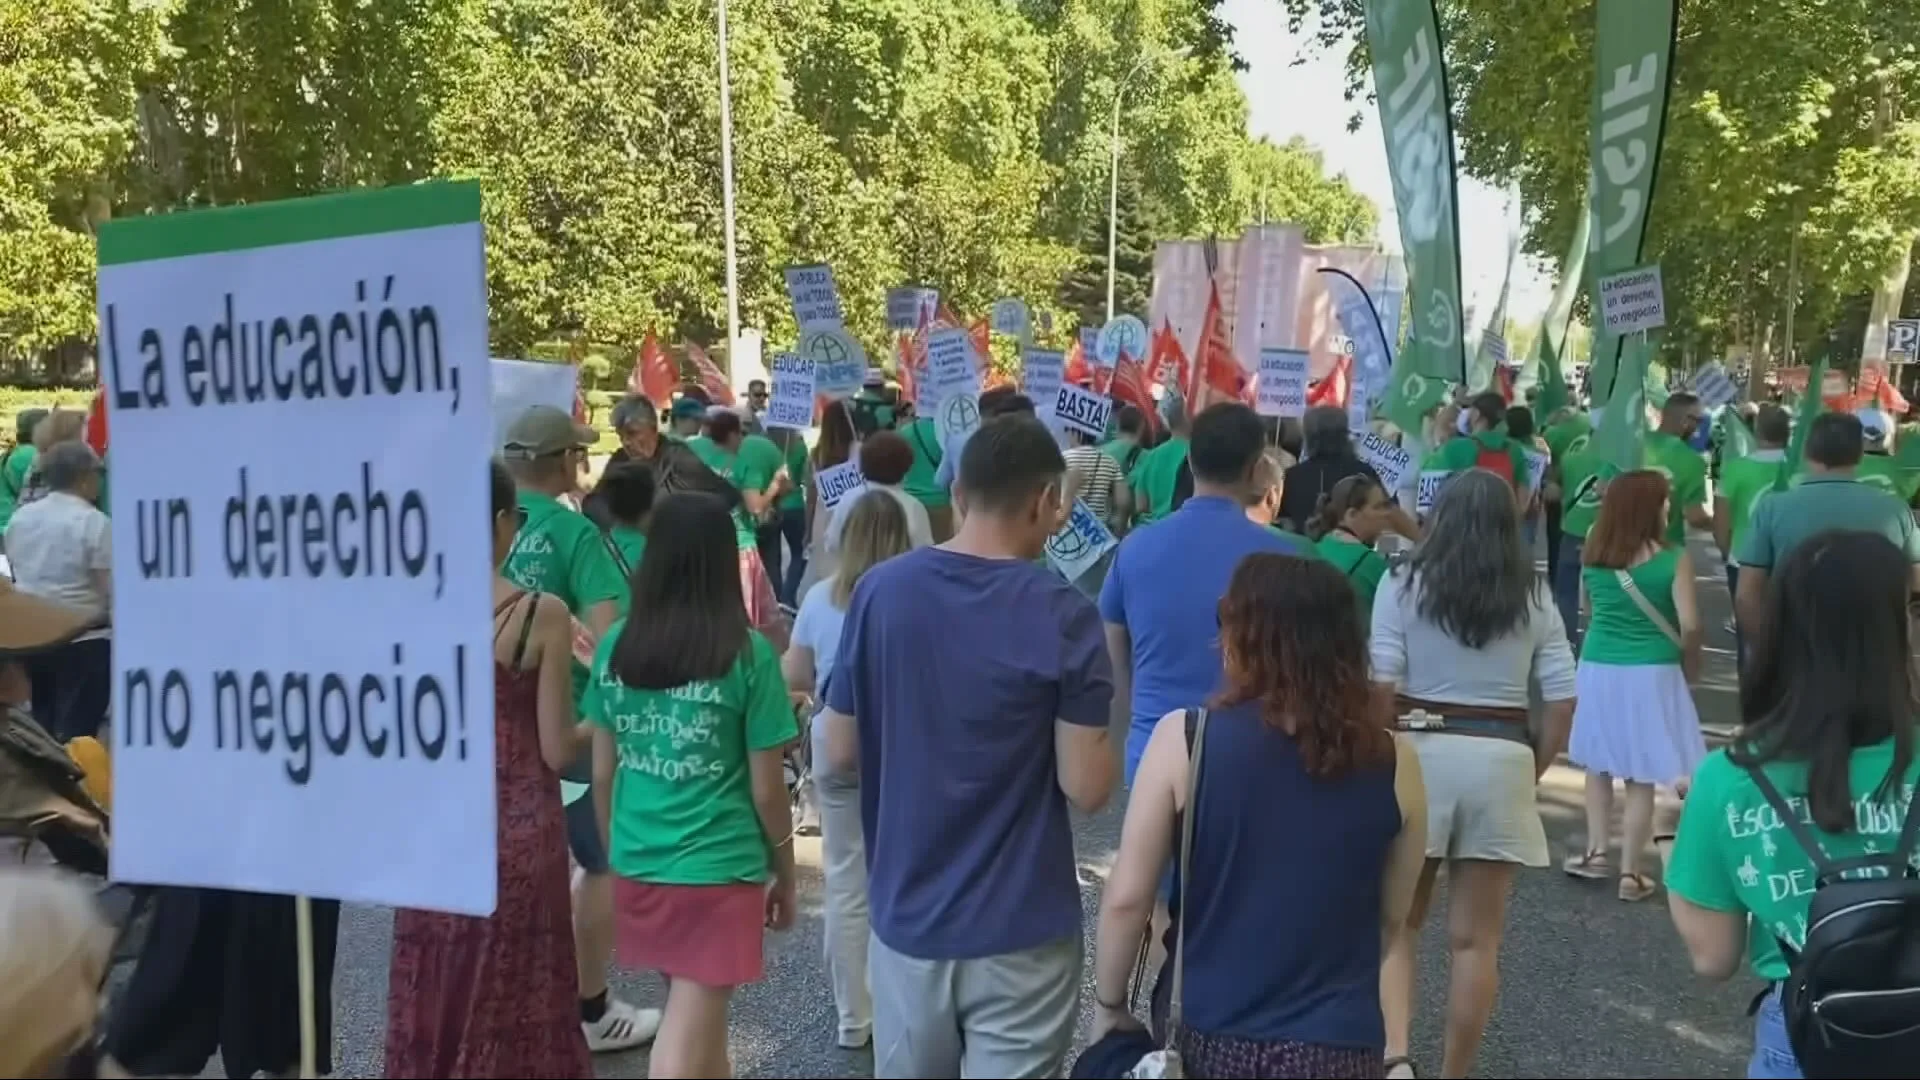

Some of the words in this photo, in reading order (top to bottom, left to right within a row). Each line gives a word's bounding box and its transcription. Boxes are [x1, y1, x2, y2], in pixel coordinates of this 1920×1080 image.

[1602, 280, 1612, 292] La
[1606, 298, 1617, 309] un
[1606, 315, 1618, 327] no
[107, 303, 169, 409] La
[183, 274, 461, 415] educación,
[773, 354, 815, 377] EDUCAR
[1056, 389, 1111, 428] BASTA!
[1363, 432, 1410, 471] EDUCAR
[137, 497, 193, 579] un
[224, 461, 444, 601] derecho,
[124, 668, 192, 749] no
[212, 643, 468, 786] negocio!
[1767, 868, 1817, 902] DE
